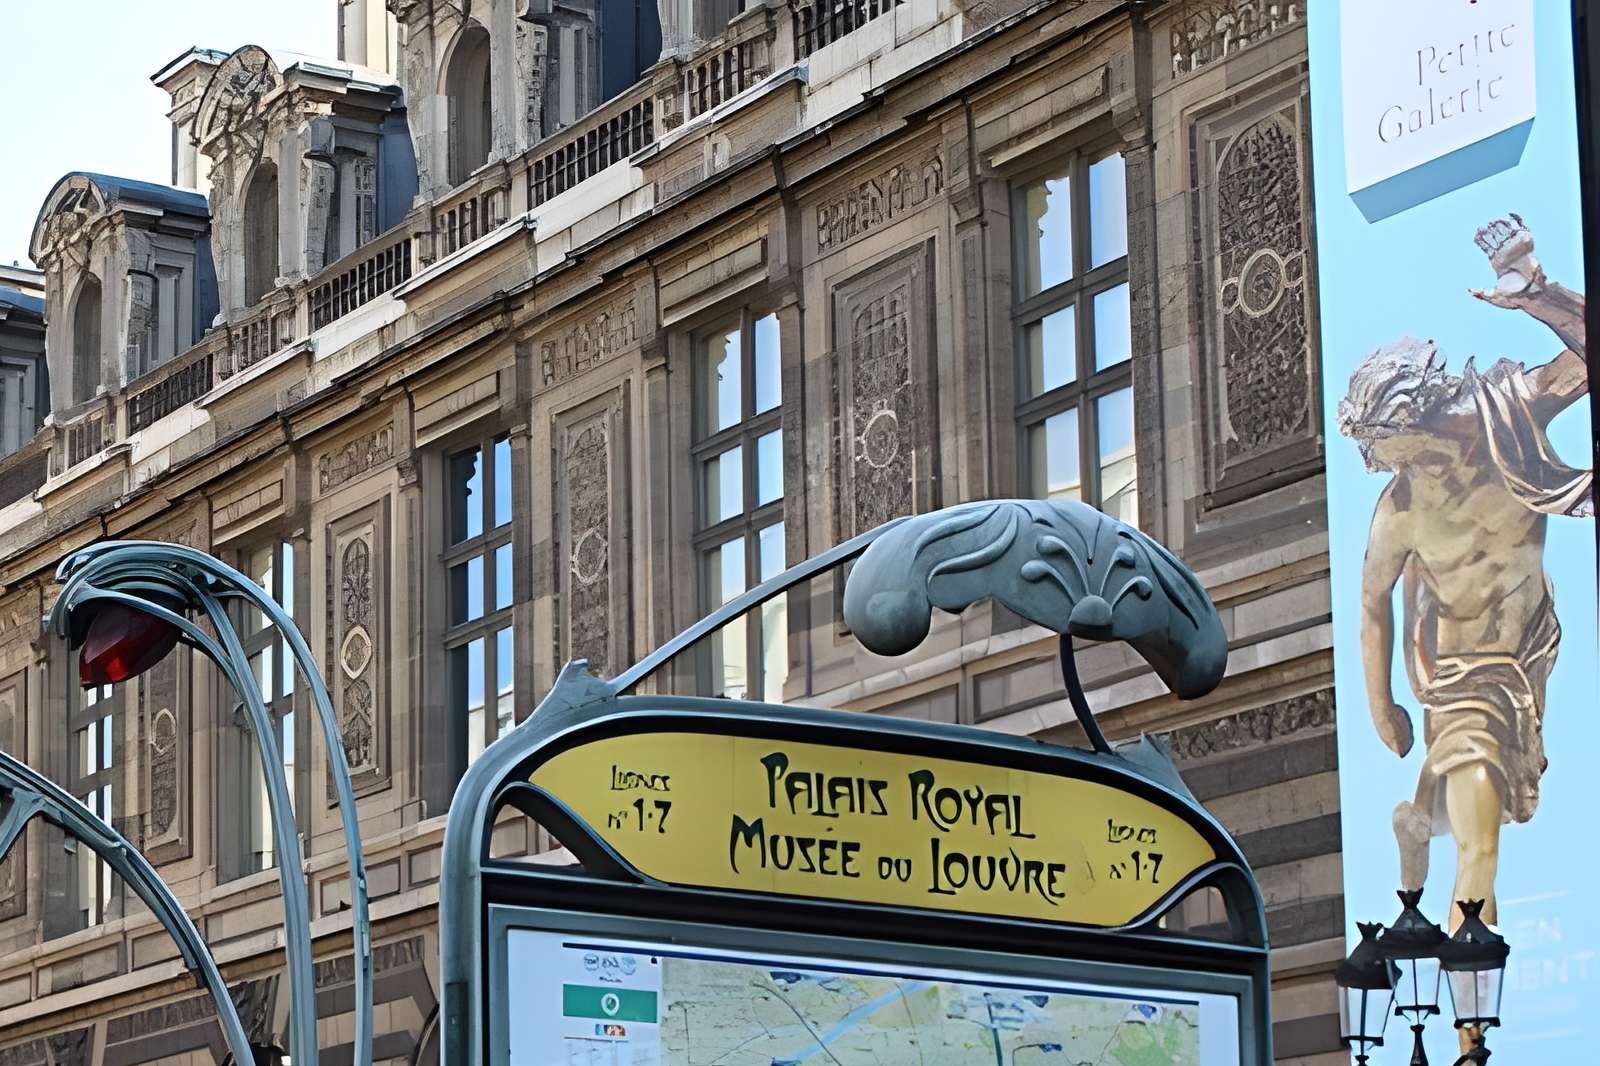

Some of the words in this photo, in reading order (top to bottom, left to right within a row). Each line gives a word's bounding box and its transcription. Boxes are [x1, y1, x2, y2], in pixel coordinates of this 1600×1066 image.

[760, 752, 889, 817] PALAIS
[908, 769, 1036, 839] ROYAL
[729, 813, 861, 878] MUSÉE
[927, 837, 1066, 906] LOUVRE
